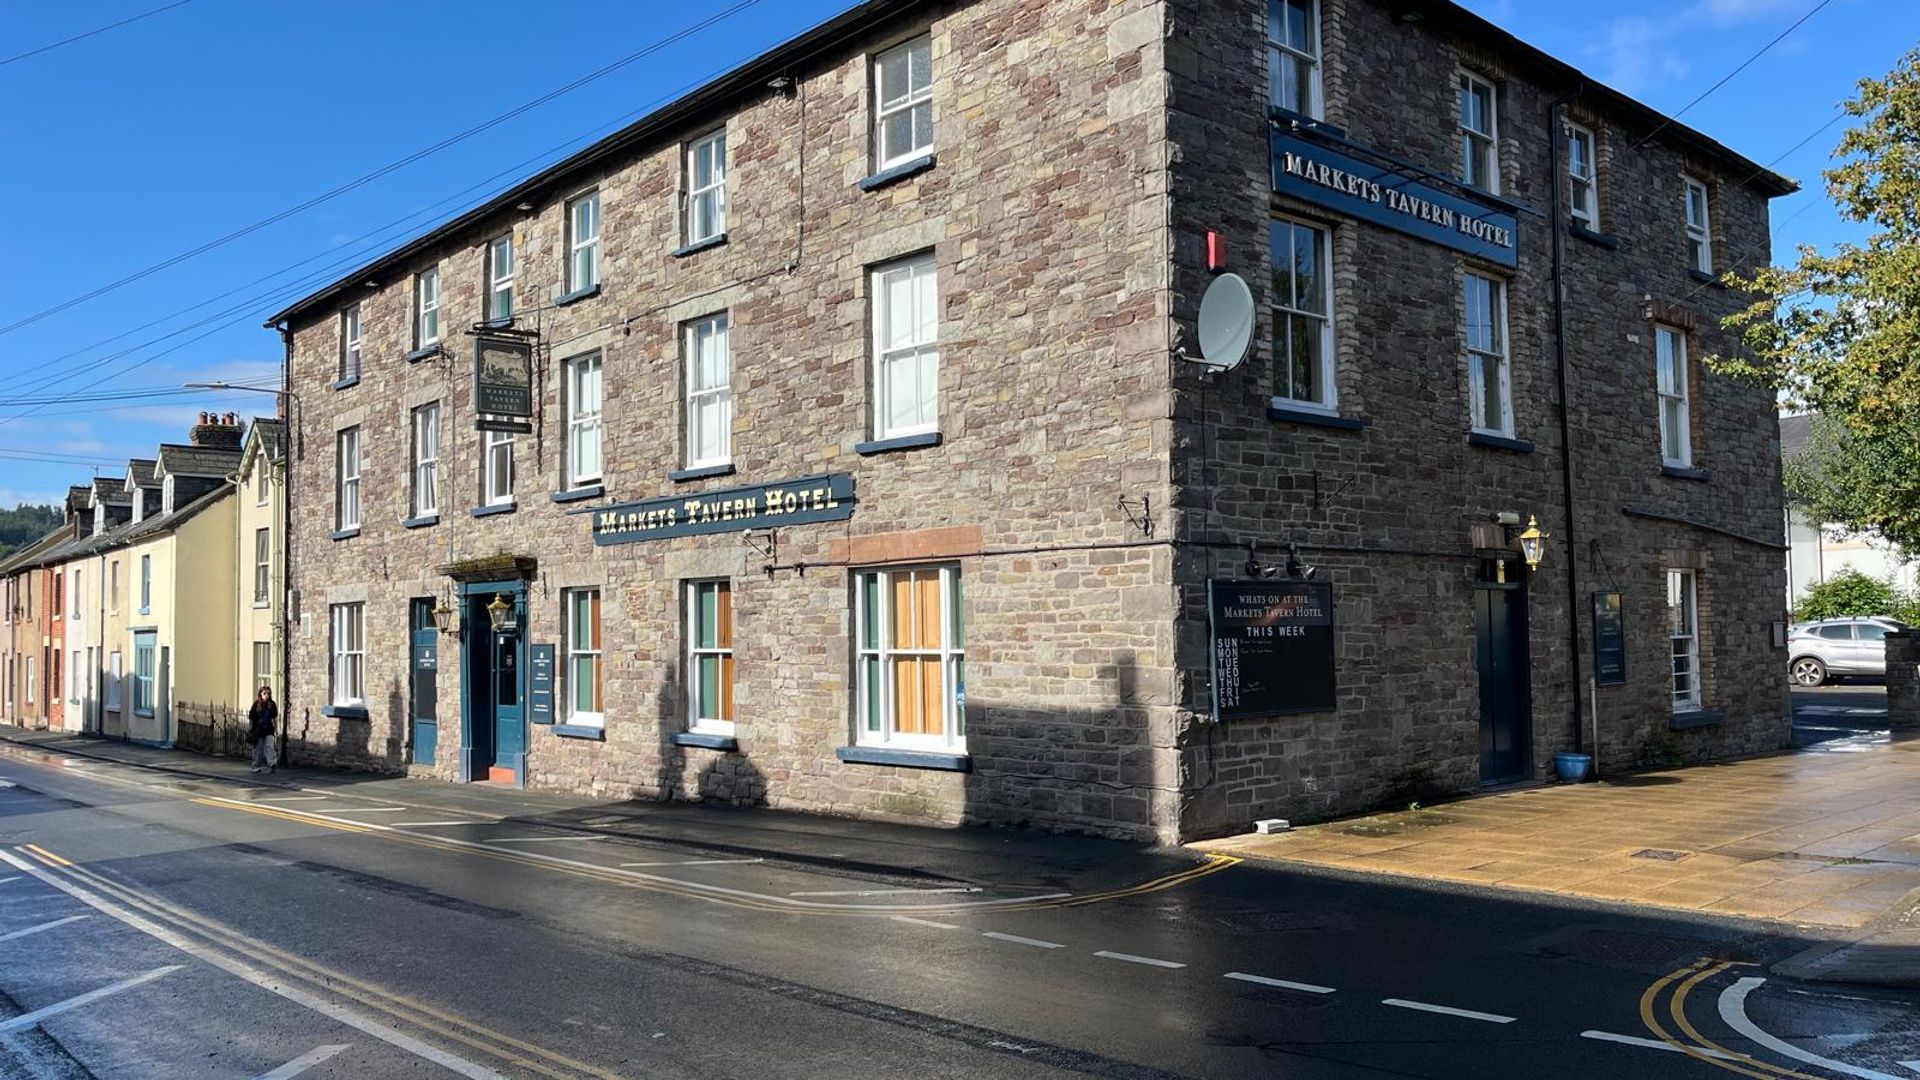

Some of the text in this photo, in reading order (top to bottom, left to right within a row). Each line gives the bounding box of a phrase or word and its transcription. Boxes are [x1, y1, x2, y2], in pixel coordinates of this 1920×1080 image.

[1285, 151, 1513, 248] MARKETS TAVERN HOTEL
[600, 487, 839, 535] MARKETS TAVERN HOTEL
[1239, 595, 1309, 604] WHATS ON AT THE
[1223, 606, 1323, 618] MARKETS TAVERN HOTEL
[1246, 626, 1305, 637] THIS WEEK
[1217, 638, 1238, 648] SUN
[1217, 648, 1238, 658] MON
[1219, 658, 1238, 667] TUE
[1218, 667, 1239, 678] WED
[1220, 677, 1240, 688] THU
[1220, 688, 1239, 699] FRI
[1220, 697, 1240, 708] SAT
